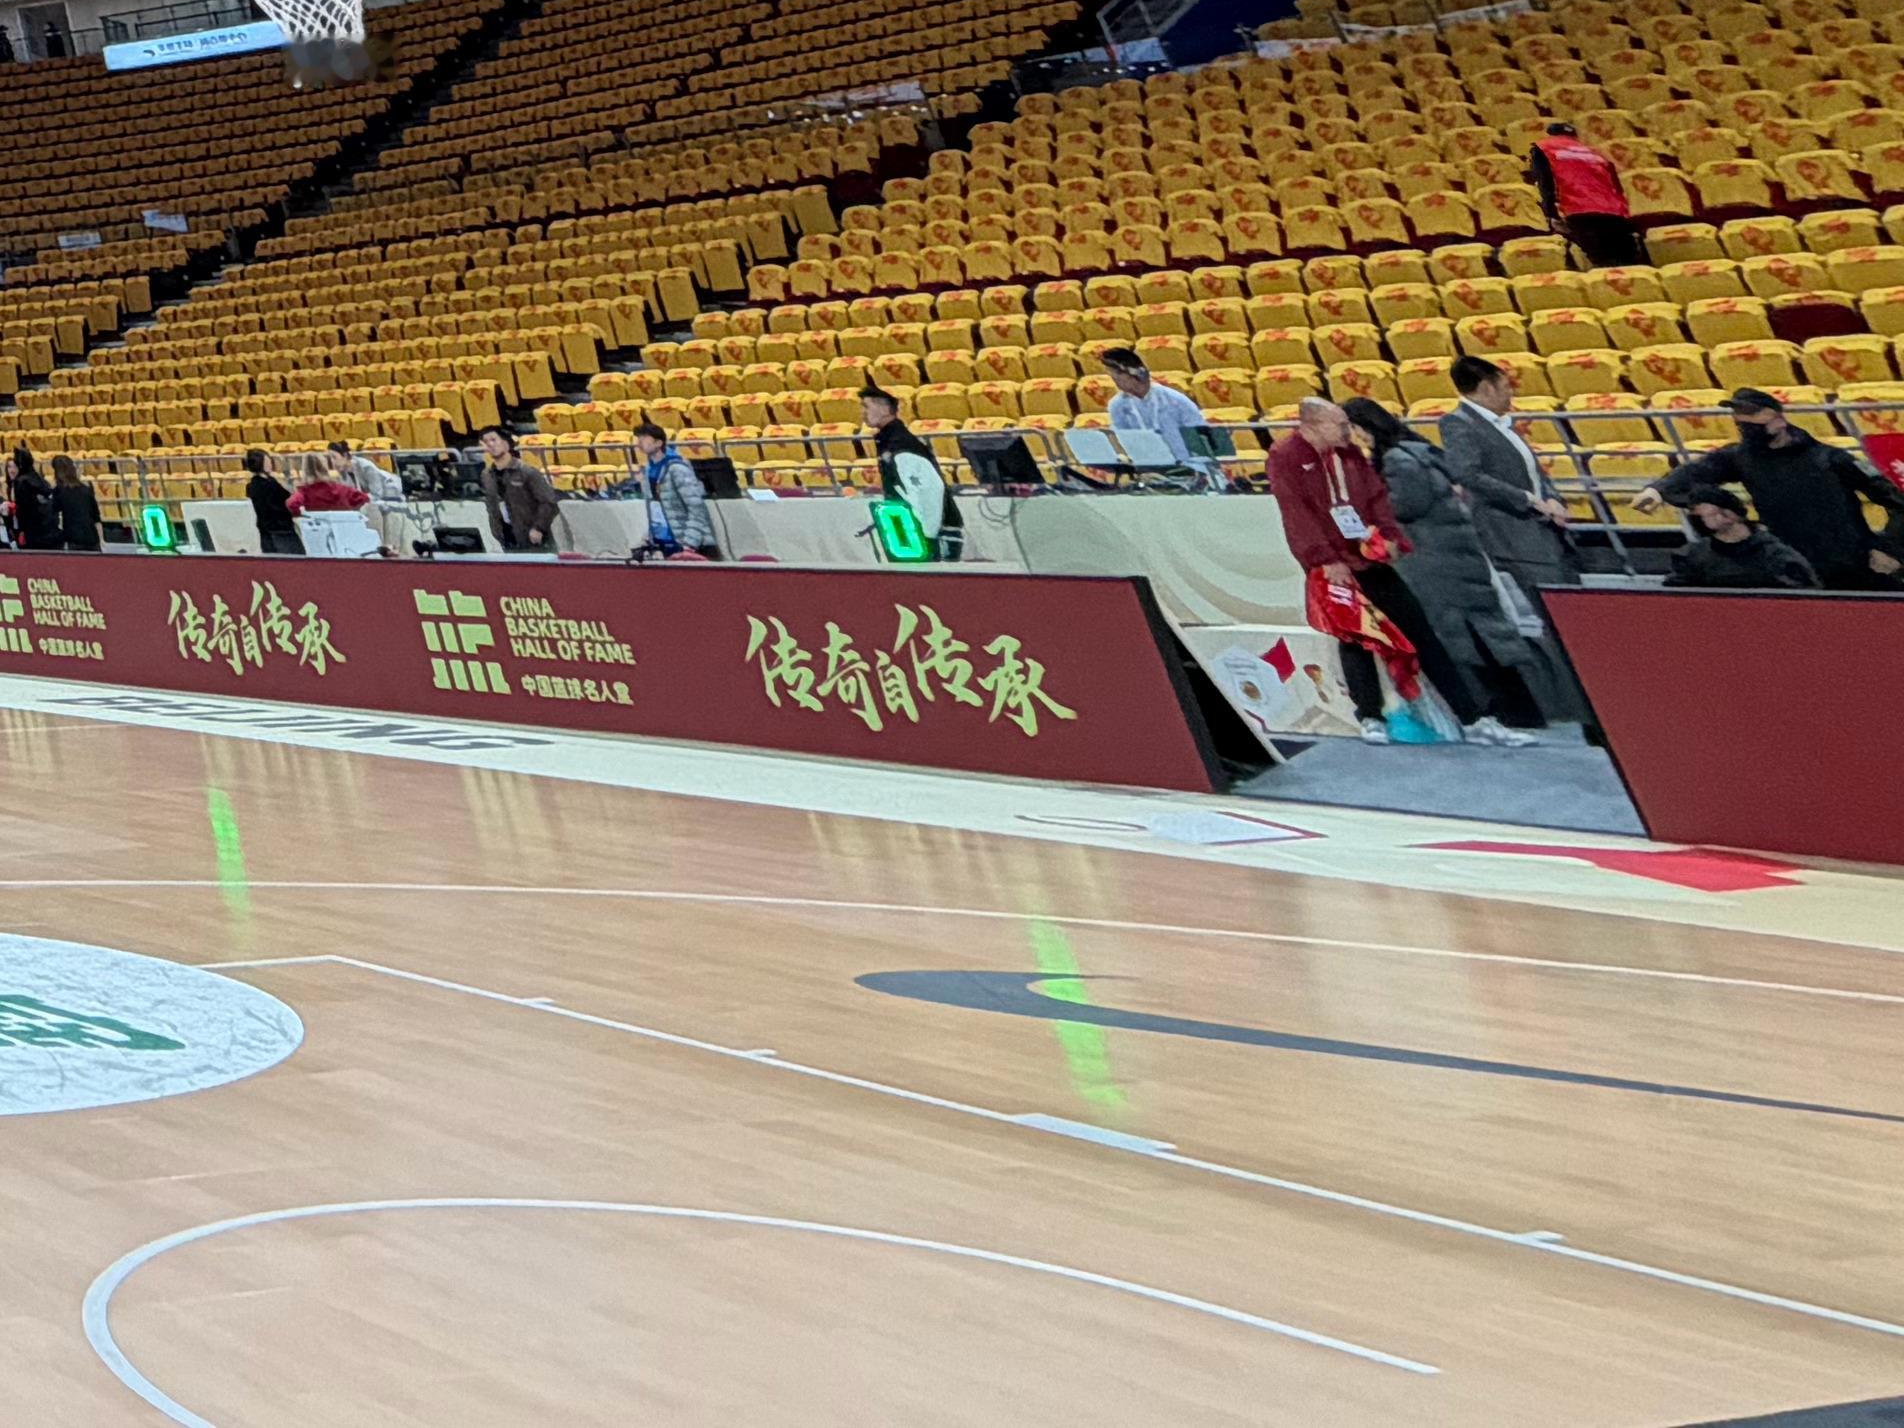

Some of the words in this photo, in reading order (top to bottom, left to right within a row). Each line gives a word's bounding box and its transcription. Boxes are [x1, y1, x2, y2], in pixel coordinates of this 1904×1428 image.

[27, 577, 60, 594] CHINA
[30, 594, 95, 613] BASKETBALL
[499, 594, 555, 619] CHINA
[33, 610, 61, 627] HALL
[61, 612, 76, 627] OF
[76, 613, 107, 630] FAME
[167, 580, 347, 676] 传奇自传承
[504, 616, 616, 644] BASKETBALL
[508, 639, 556, 663] HALL
[556, 641, 582, 663] OF
[583, 640, 637, 666] FAME
[745, 603, 1078, 738] 传奇自传承
[521, 673, 635, 706] 中国篮球名人堂
[35, 695, 556, 751] BEIJING
